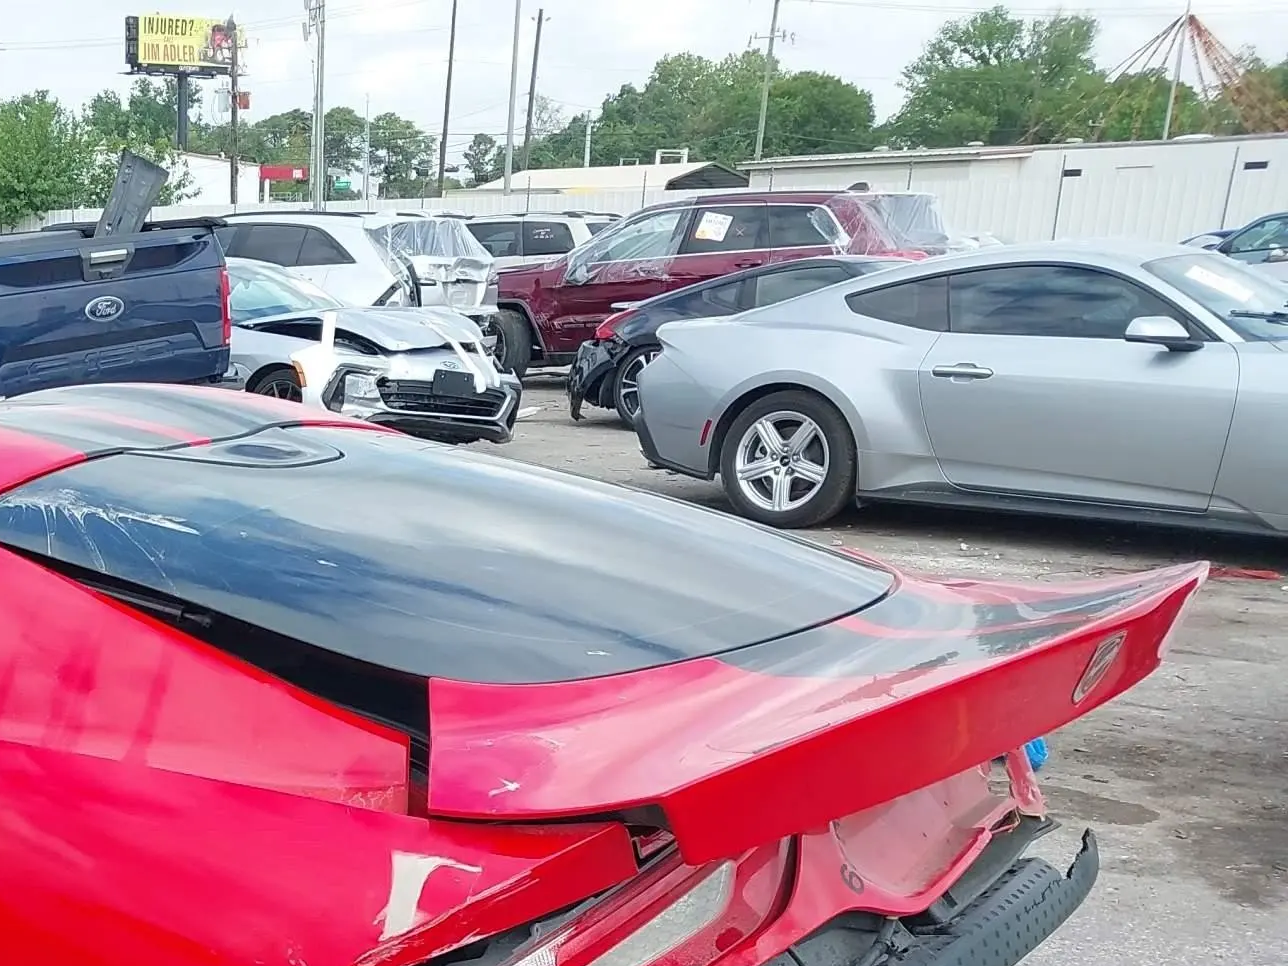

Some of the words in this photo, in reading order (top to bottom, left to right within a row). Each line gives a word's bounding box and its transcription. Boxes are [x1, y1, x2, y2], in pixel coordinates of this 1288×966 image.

[143, 16, 194, 37] INJURED?
[142, 42, 160, 61] JIM
[163, 44, 195, 63] ADLER
[95, 301, 117, 316] Ford
